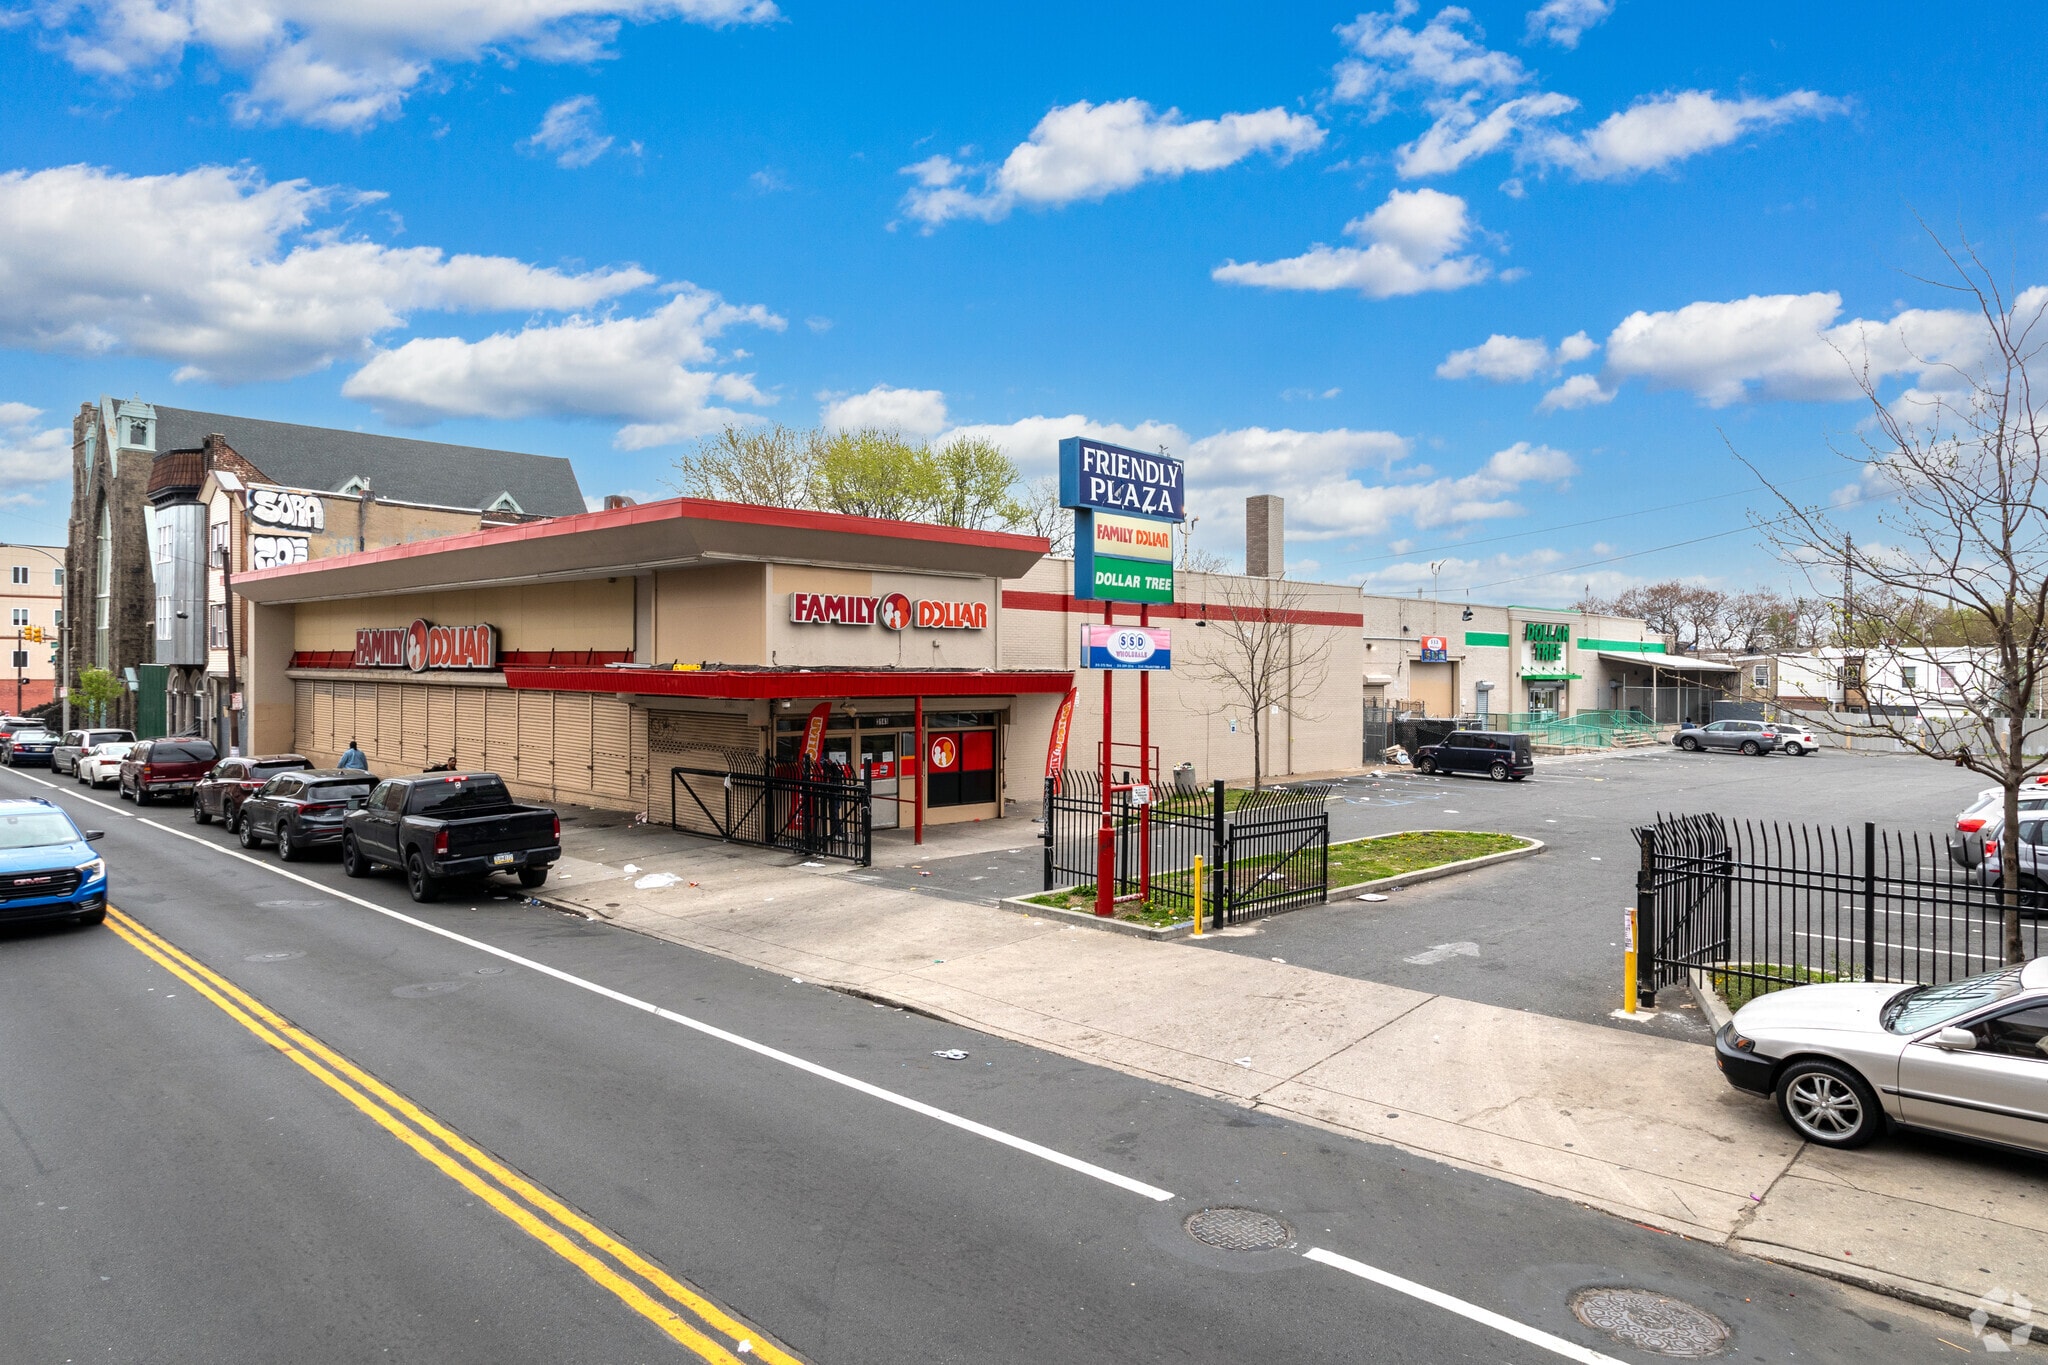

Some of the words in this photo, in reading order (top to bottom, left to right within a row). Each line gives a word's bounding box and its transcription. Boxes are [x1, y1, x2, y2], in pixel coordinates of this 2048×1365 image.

[1083, 446, 1179, 488] FRIENDLY
[1090, 477, 1174, 514] PLAZA
[1097, 523, 1134, 544] FAMILY
[1136, 529, 1169, 548] DOLLAR
[1095, 571, 1141, 589] DOLLAR
[1145, 576, 1172, 591] TREE
[791, 592, 880, 625] FAMILY
[915, 599, 988, 629] DOLLAR
[1120, 635, 1144, 647] SSD
[1525, 623, 1570, 642] DOLLAR
[356, 628, 407, 666] FAMILY
[430, 624, 491, 667] DOLLAR
[1116, 650, 1148, 658] WHOLESALE
[1534, 643, 1562, 661] TREE
[806, 716, 823, 763] OLLAR
